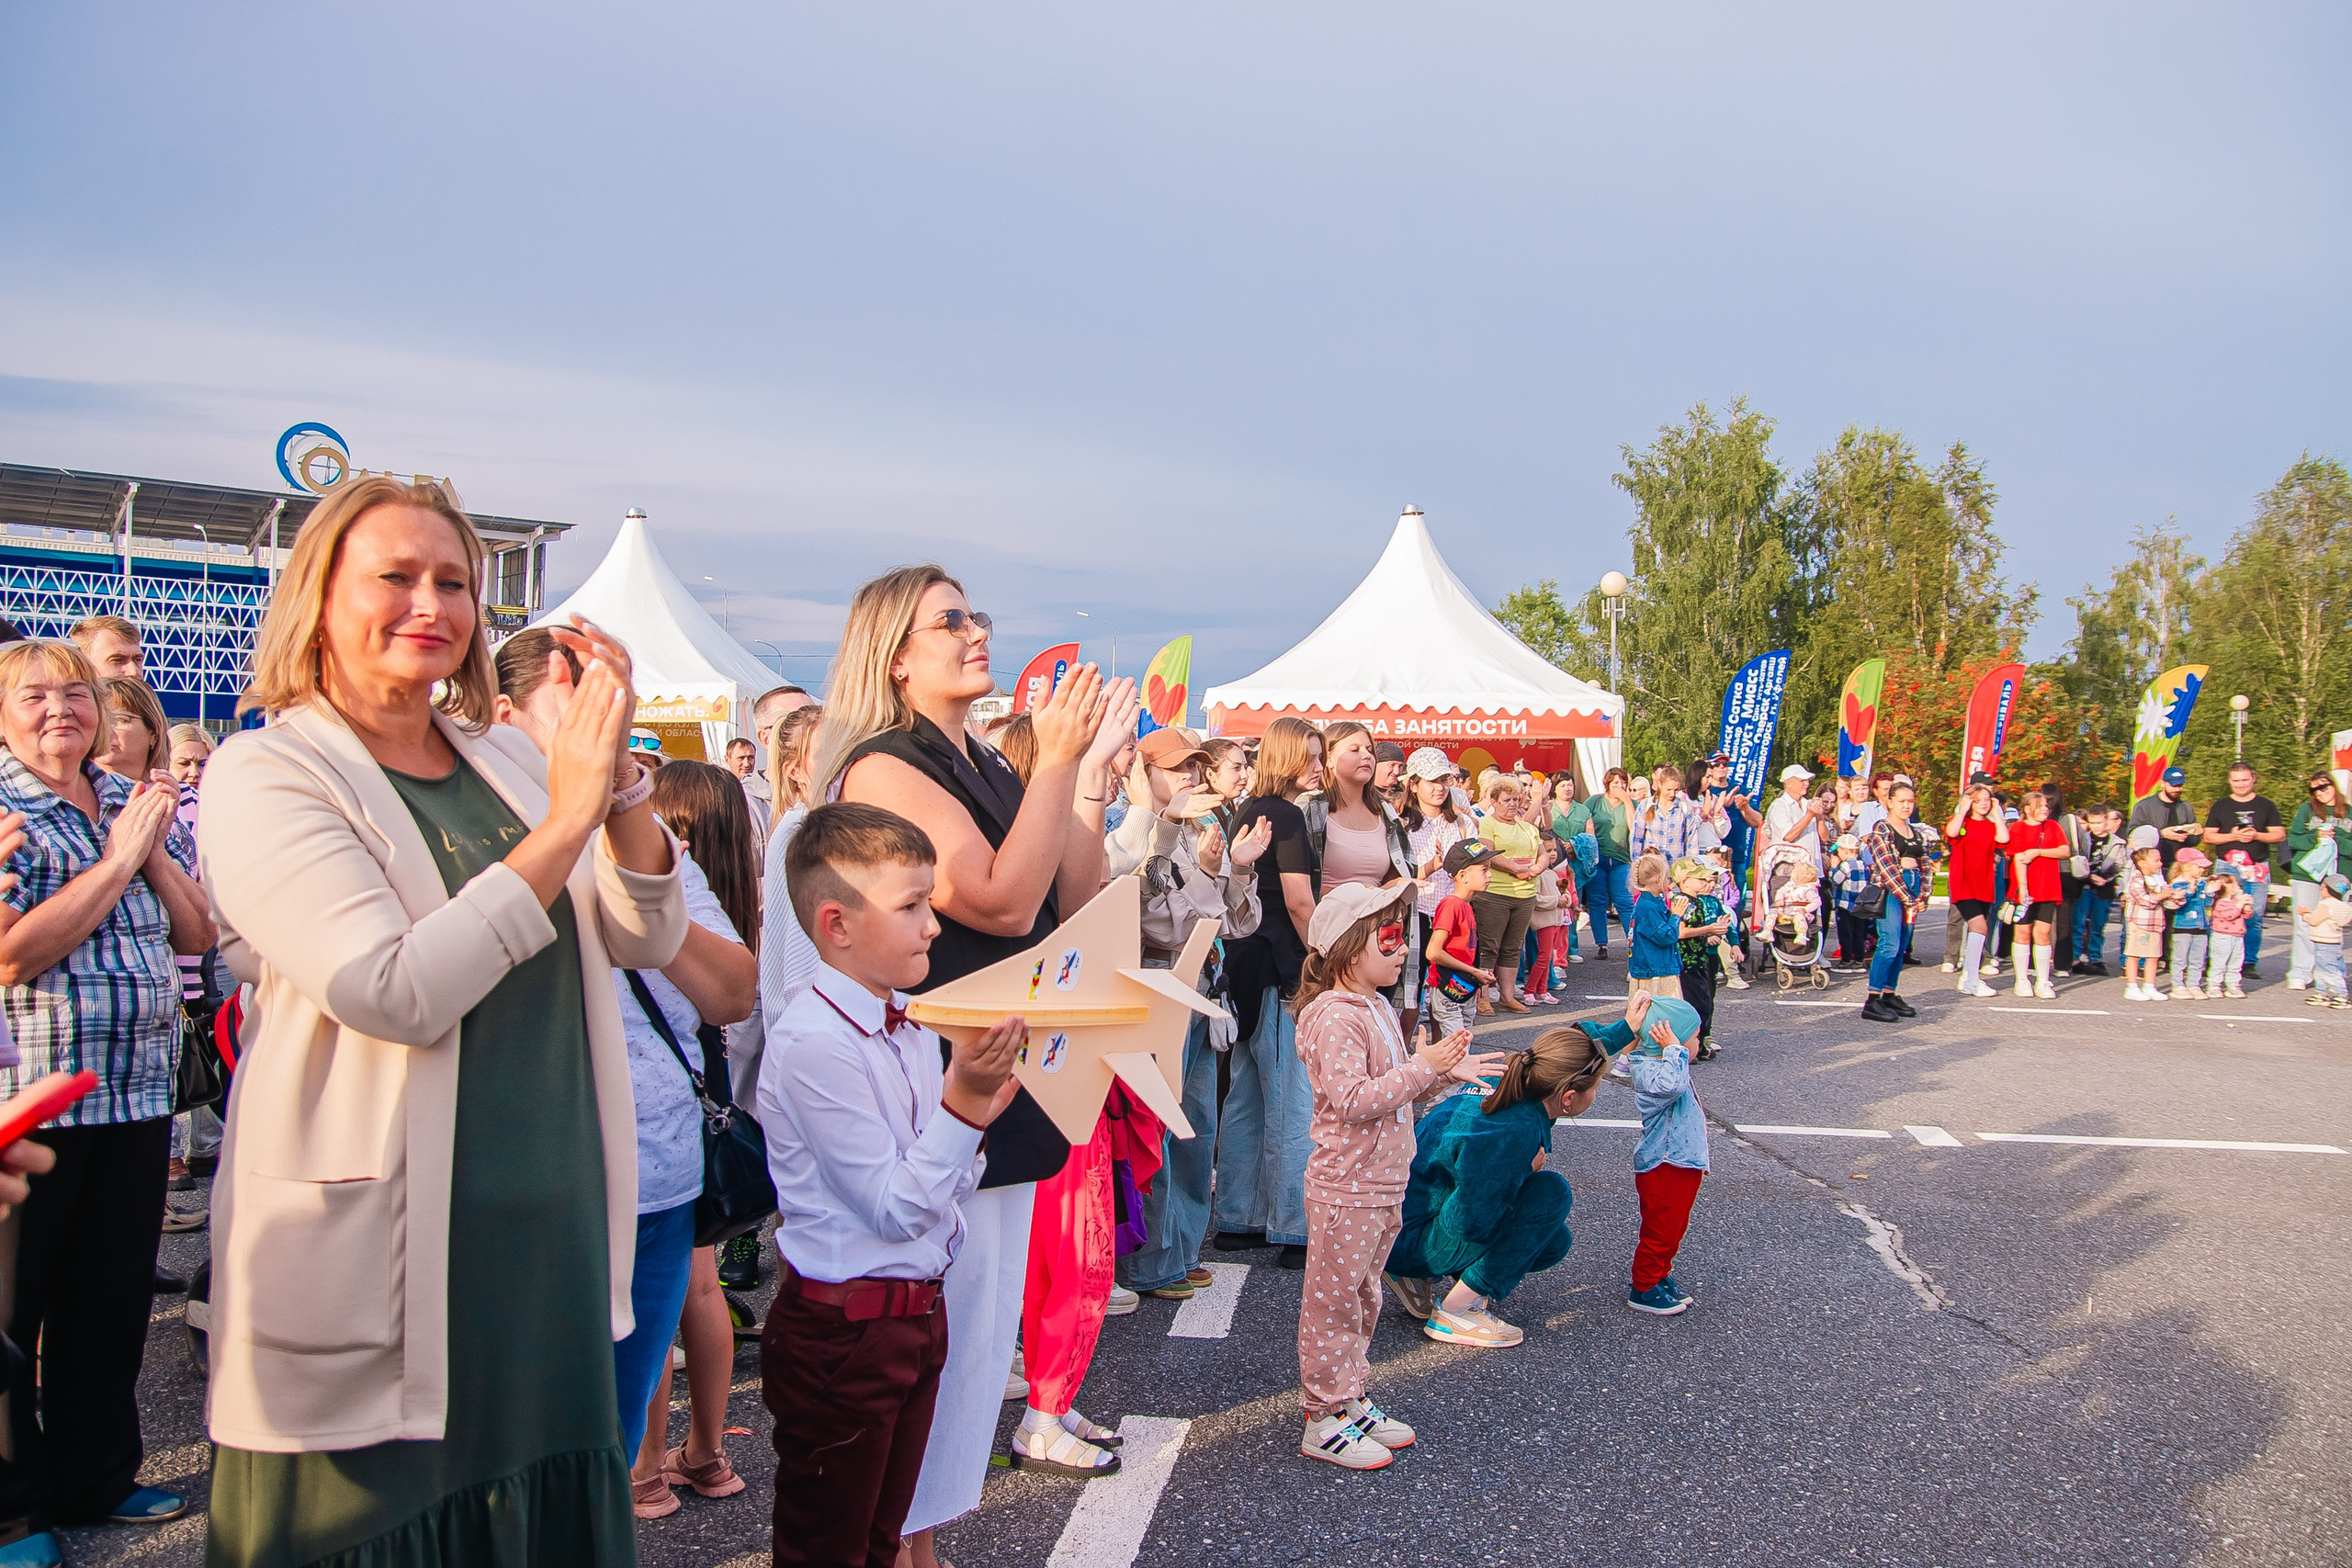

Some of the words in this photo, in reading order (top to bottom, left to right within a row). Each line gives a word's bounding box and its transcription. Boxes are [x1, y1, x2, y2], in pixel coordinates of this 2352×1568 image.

[1740, 669, 1759, 718] Миасс
[1764, 657, 1777, 695] Аргаяш
[635, 705, 710, 718] НОЖАТЬ.
[1728, 682, 1744, 724] Сатка
[1395, 719, 1527, 735] ЗАНЯТОСТИ
[1752, 721, 1773, 795] Вишневогорск
[1771, 657, 1788, 701] Уфалей
[1414, 740, 1459, 750] ОБЛАСТИ
[1731, 727, 1743, 762] Миньяр
[1734, 723, 1754, 785] латоуст
[1087, 1267, 1114, 1281] GROU
